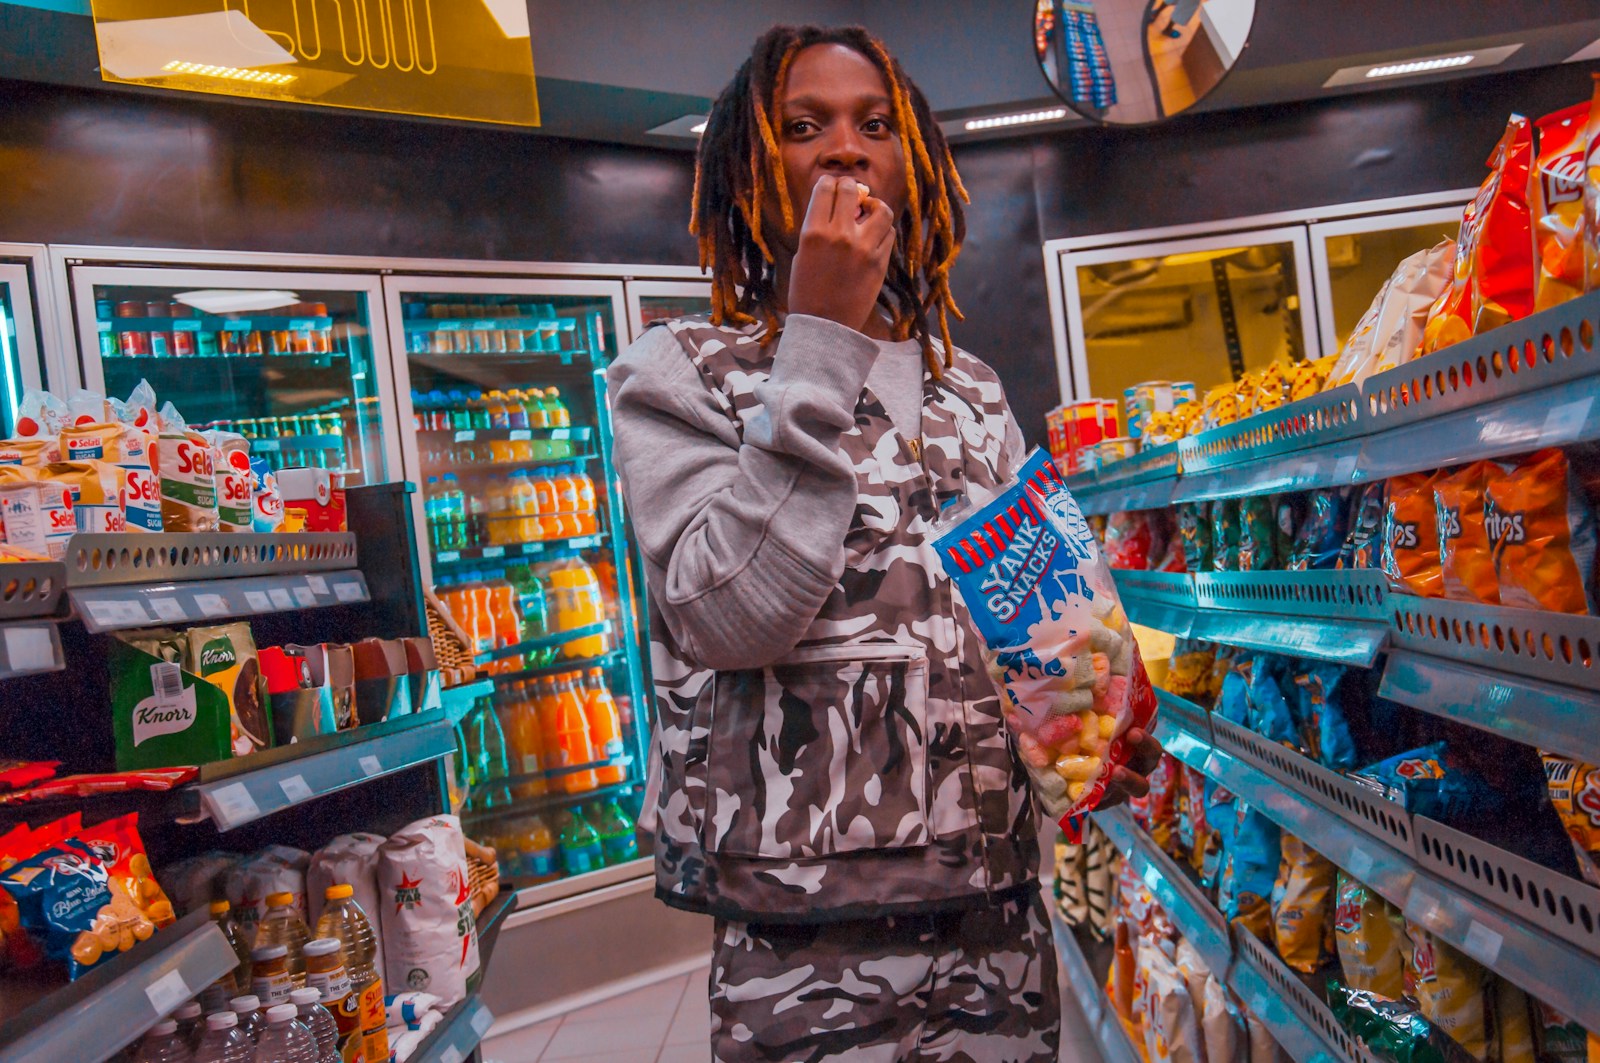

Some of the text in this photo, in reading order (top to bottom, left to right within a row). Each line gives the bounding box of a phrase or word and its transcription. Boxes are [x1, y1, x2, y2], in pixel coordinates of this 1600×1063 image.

[980, 516, 1041, 590] YANK
[987, 531, 1057, 620] SNACKS
[202, 650, 235, 667] Knorr
[136, 706, 191, 725] Knorr
